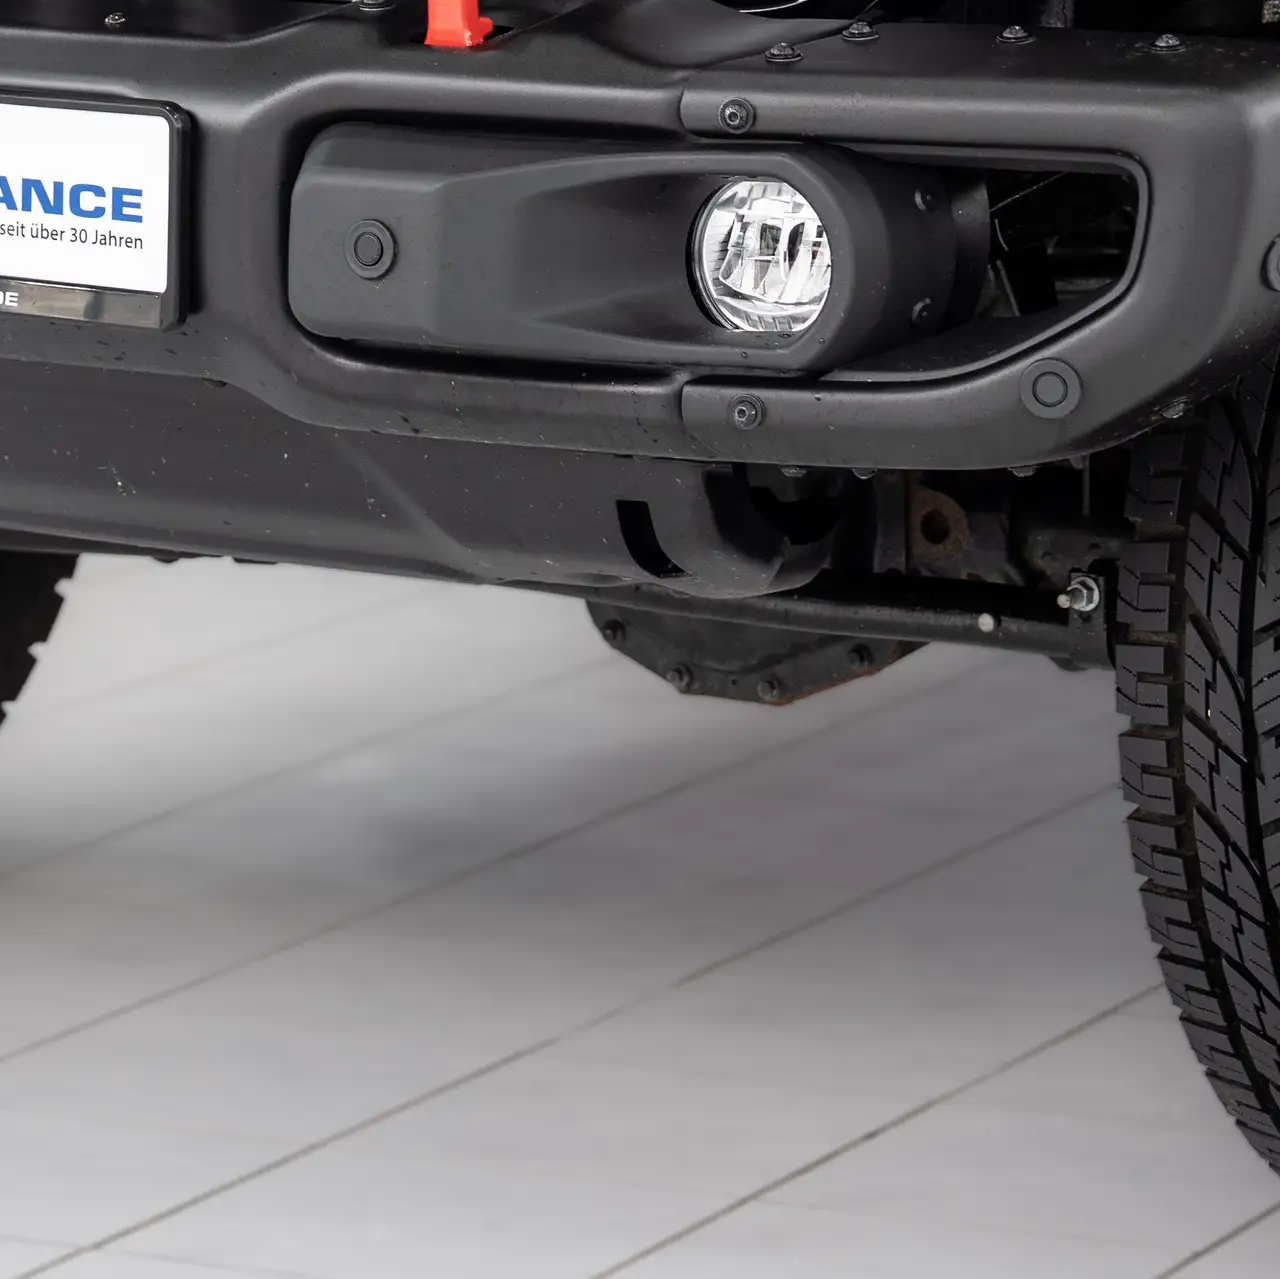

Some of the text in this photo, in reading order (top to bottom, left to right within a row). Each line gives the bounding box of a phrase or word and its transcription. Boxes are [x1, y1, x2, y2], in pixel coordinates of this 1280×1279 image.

[0, 220, 27, 238] seit
[30, 223, 66, 242] über
[70, 227, 89, 245] 30
[92, 229, 144, 250] Jahren
